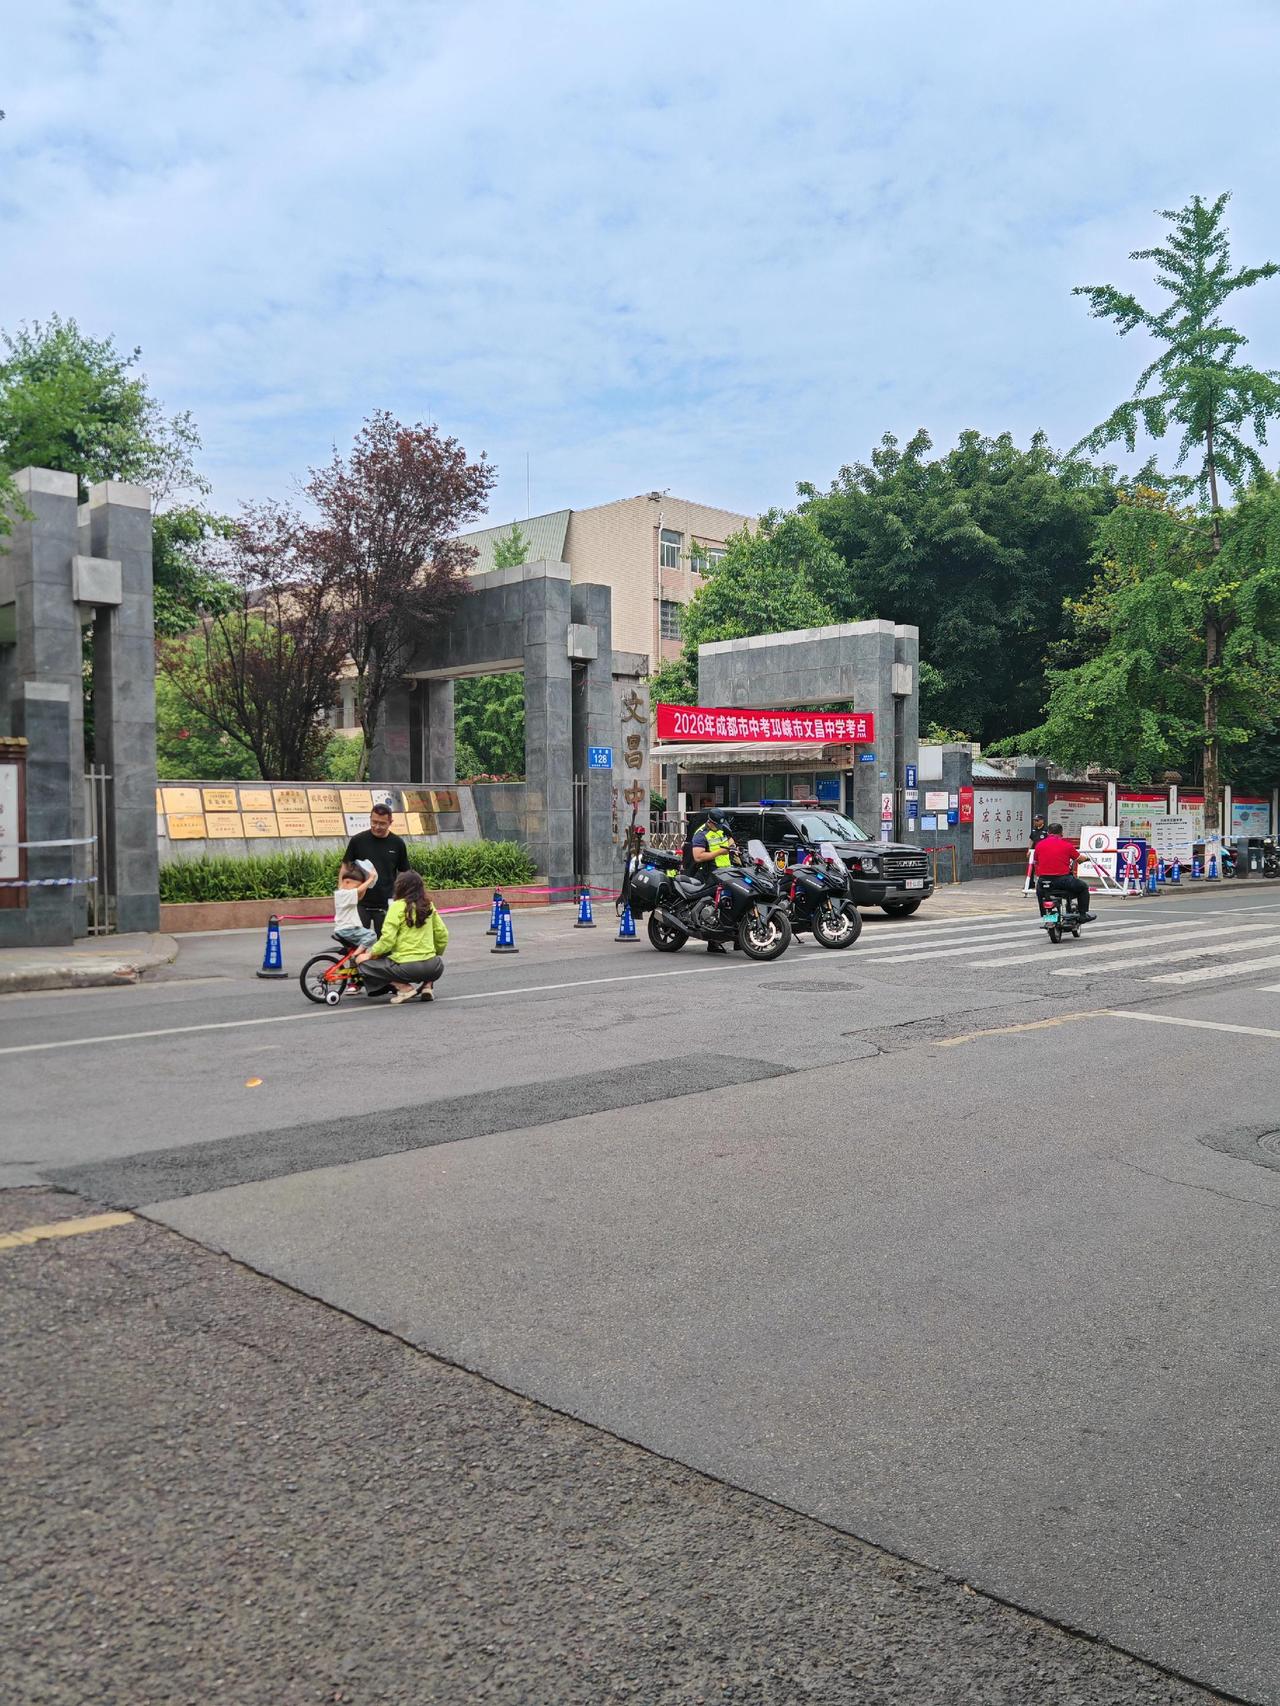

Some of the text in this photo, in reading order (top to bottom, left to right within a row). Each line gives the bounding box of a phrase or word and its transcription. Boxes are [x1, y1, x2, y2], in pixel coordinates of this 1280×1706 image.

[673, 712, 867, 739] 2026年成都市中考邛崃市文昌中学考点
[594, 753, 608, 764] 128
